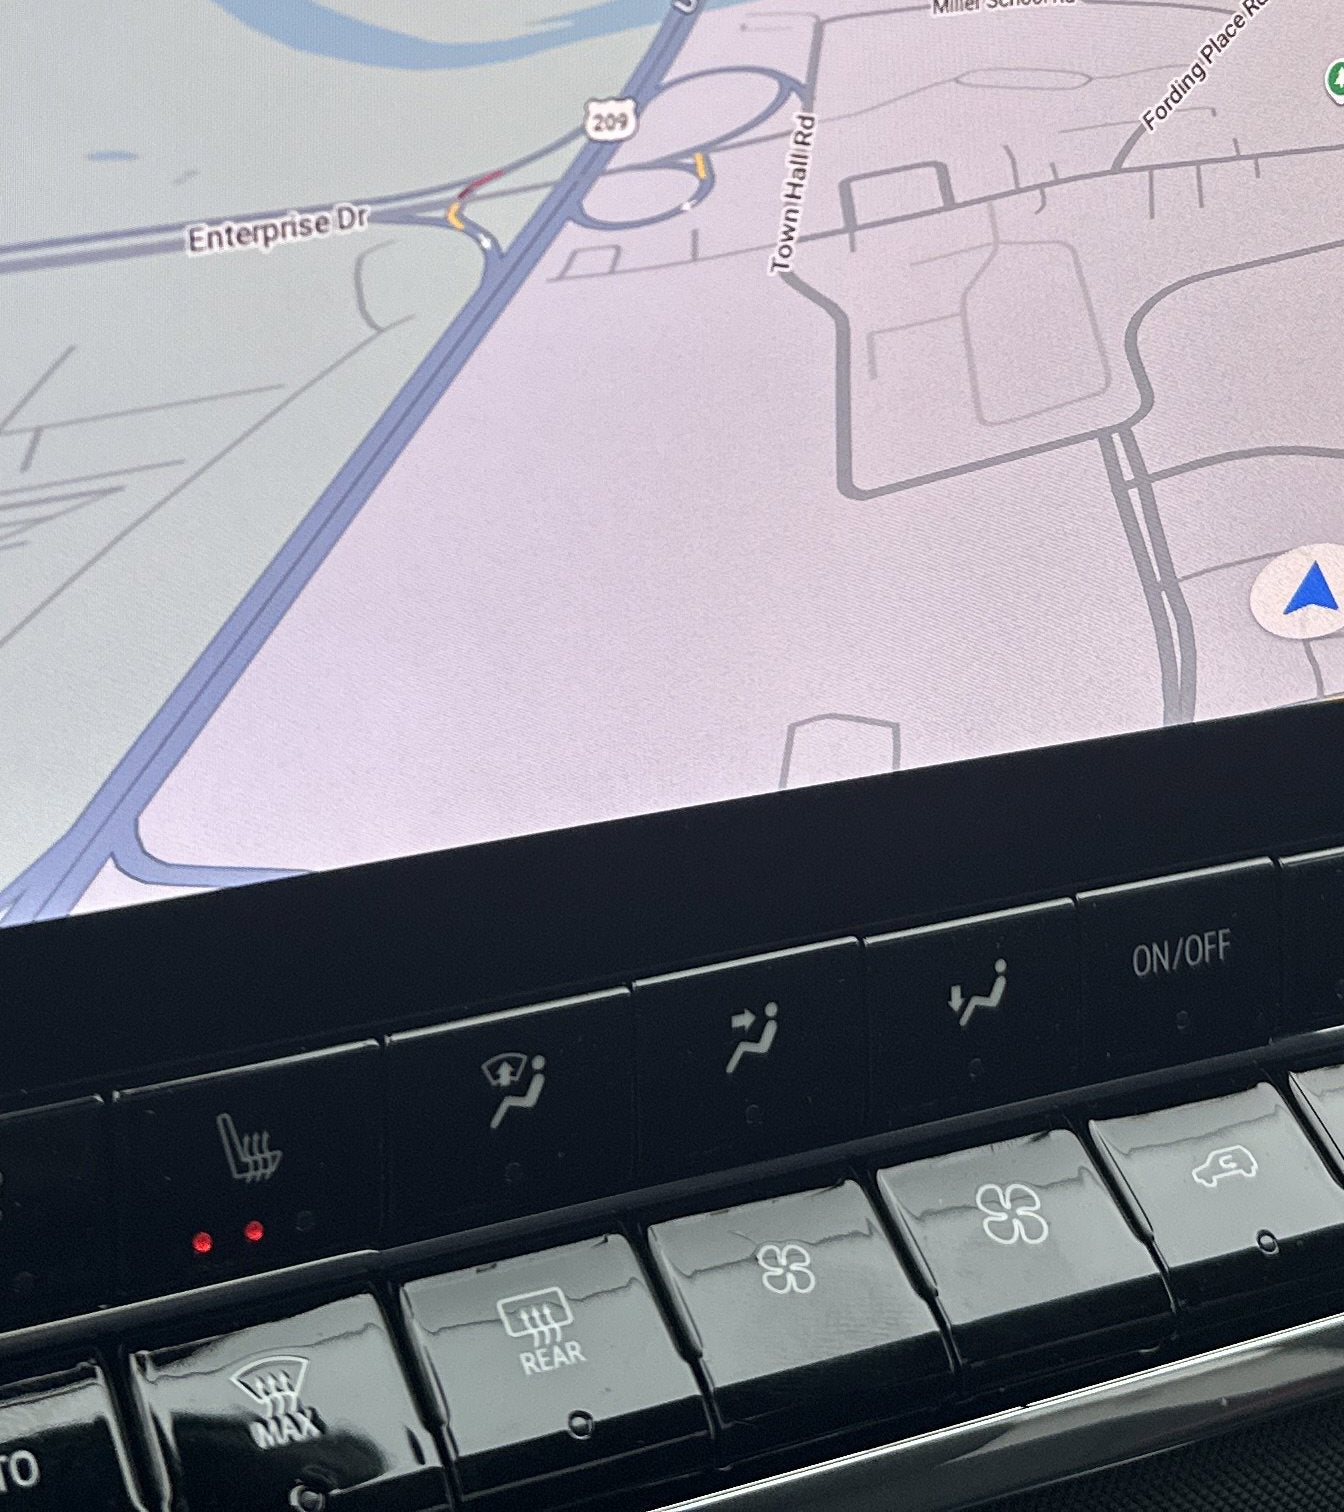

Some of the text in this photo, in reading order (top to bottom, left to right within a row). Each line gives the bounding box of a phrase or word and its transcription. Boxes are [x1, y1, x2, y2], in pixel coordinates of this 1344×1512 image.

[1143, 61, 1206, 130] Fording
[1201, 12, 1246, 65] Place
[592, 112, 628, 131] 209
[771, 115, 815, 273] Town Hall Rd
[188, 204, 368, 254] Enterprise Dr
[1132, 927, 1231, 979] ON/OFF
[519, 1339, 587, 1376] REAR
[249, 1407, 321, 1449] MAX
